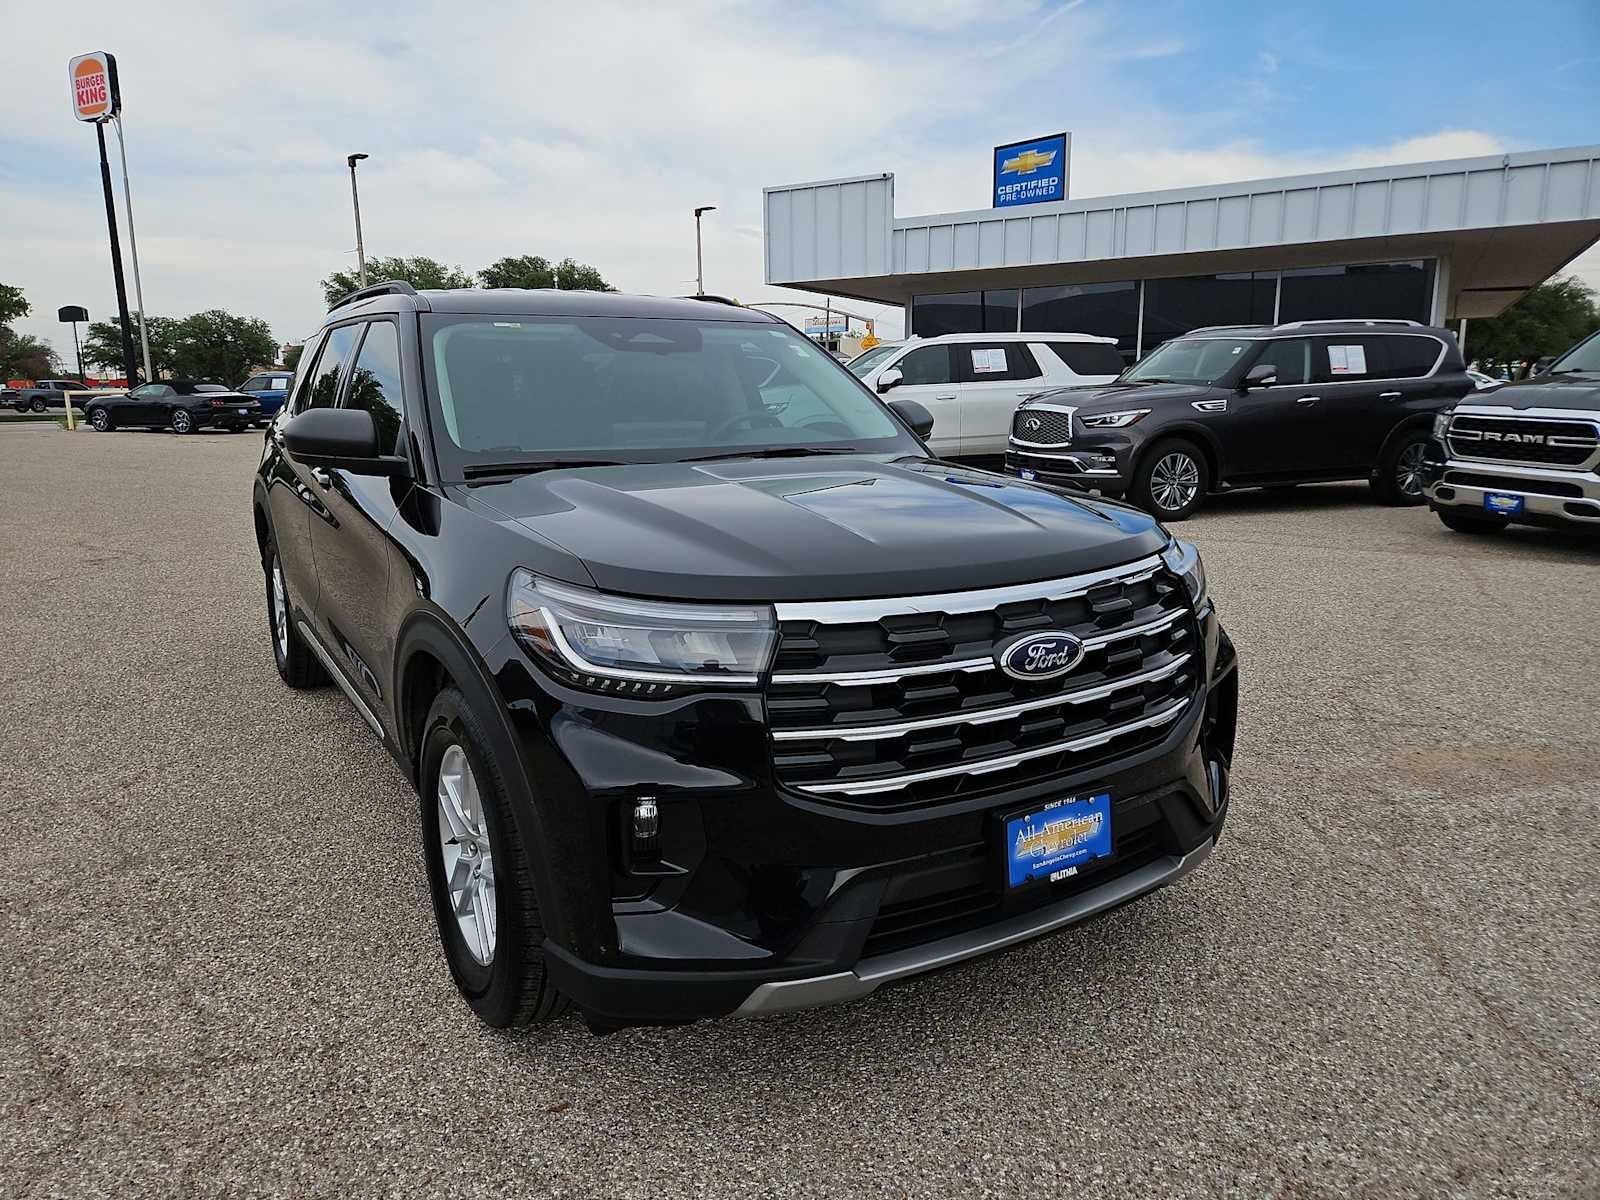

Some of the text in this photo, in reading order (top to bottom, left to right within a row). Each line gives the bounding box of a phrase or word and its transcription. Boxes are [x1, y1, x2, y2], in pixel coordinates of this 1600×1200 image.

[75, 74, 105, 90] BURGER
[77, 86, 107, 106] KING
[998, 177, 1058, 194] CERTIFIED
[1000, 186, 1055, 202] PRE-OWNED
[1483, 432, 1544, 444] RAM
[1025, 642, 1068, 671] Ford
[1044, 800, 1062, 811] SINCE
[1015, 811, 1104, 845] All American
[1030, 829, 1088, 857] Chevrolet
